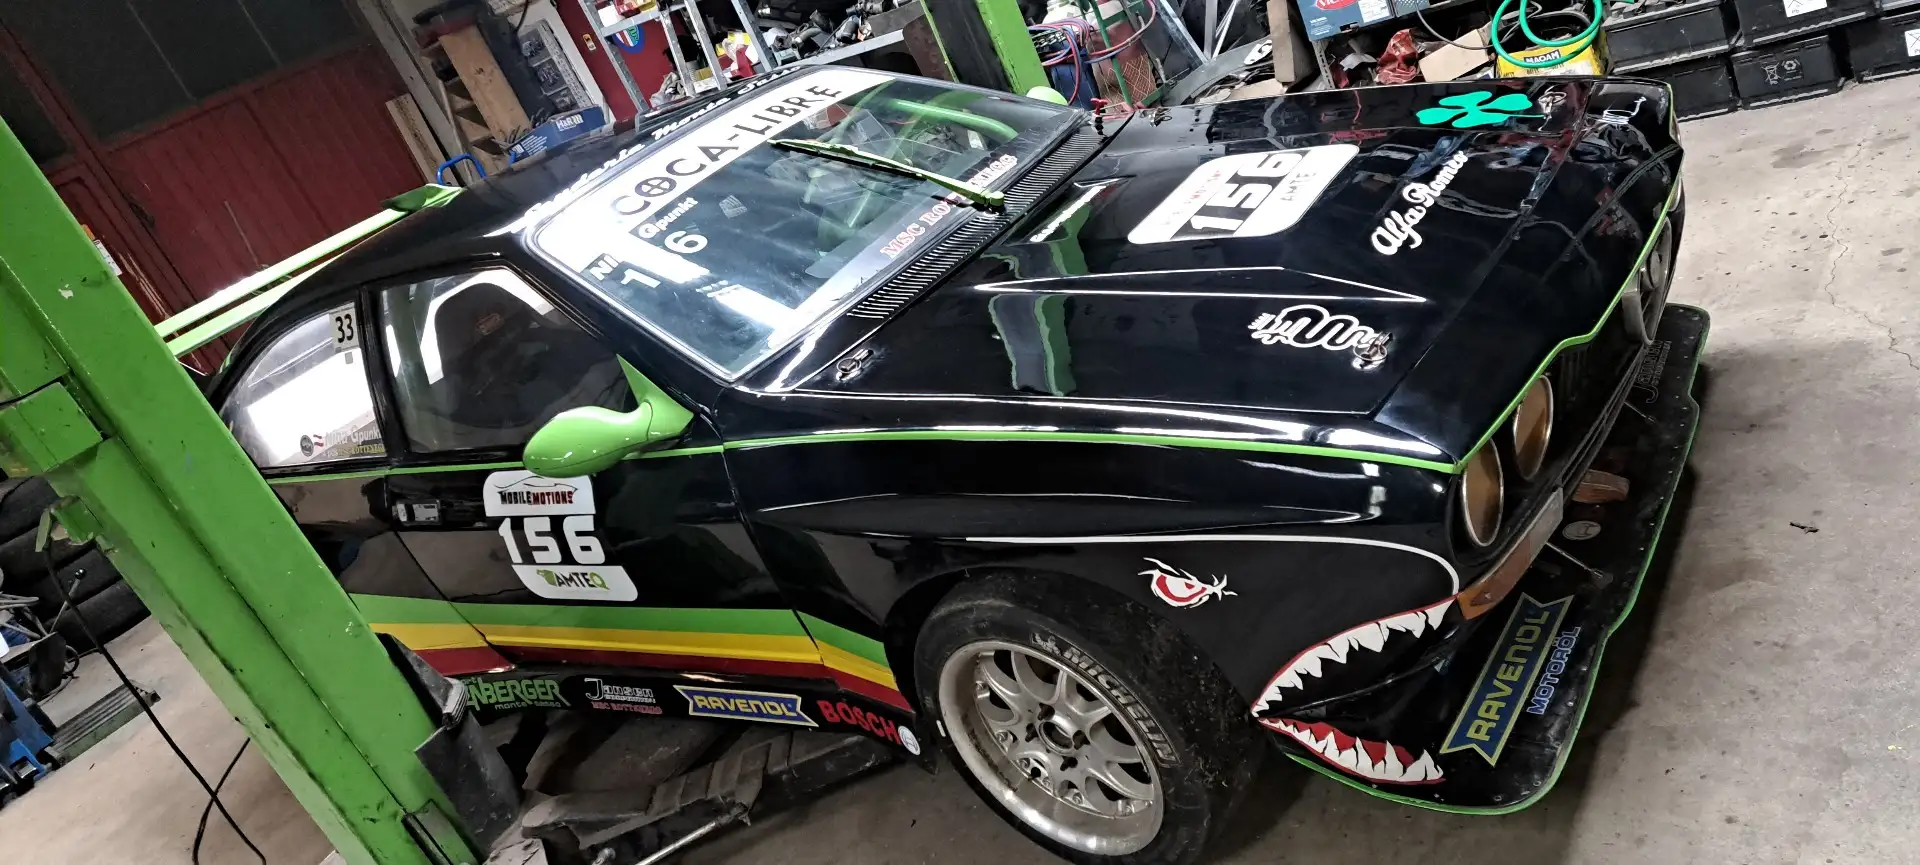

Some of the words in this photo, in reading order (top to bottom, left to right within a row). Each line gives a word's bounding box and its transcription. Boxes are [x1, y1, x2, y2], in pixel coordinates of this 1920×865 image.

[1525, 51, 1560, 63] MAOAM
[1190, 153, 1303, 231] 156
[1371, 205, 1427, 255] Alfa
[1402, 150, 1468, 208] Romeo
[880, 222, 925, 259] MSC
[335, 314, 354, 343] 33
[498, 515, 606, 565] 156
[556, 571, 610, 590] AMTEQ
[1466, 610, 1550, 741] RAVENOL
[1526, 626, 1582, 716] MOTORÖL
[692, 695, 798, 717] RAVENOL
[816, 700, 902, 744] BOSCH
[1063, 646, 1177, 762] MICHELIN
